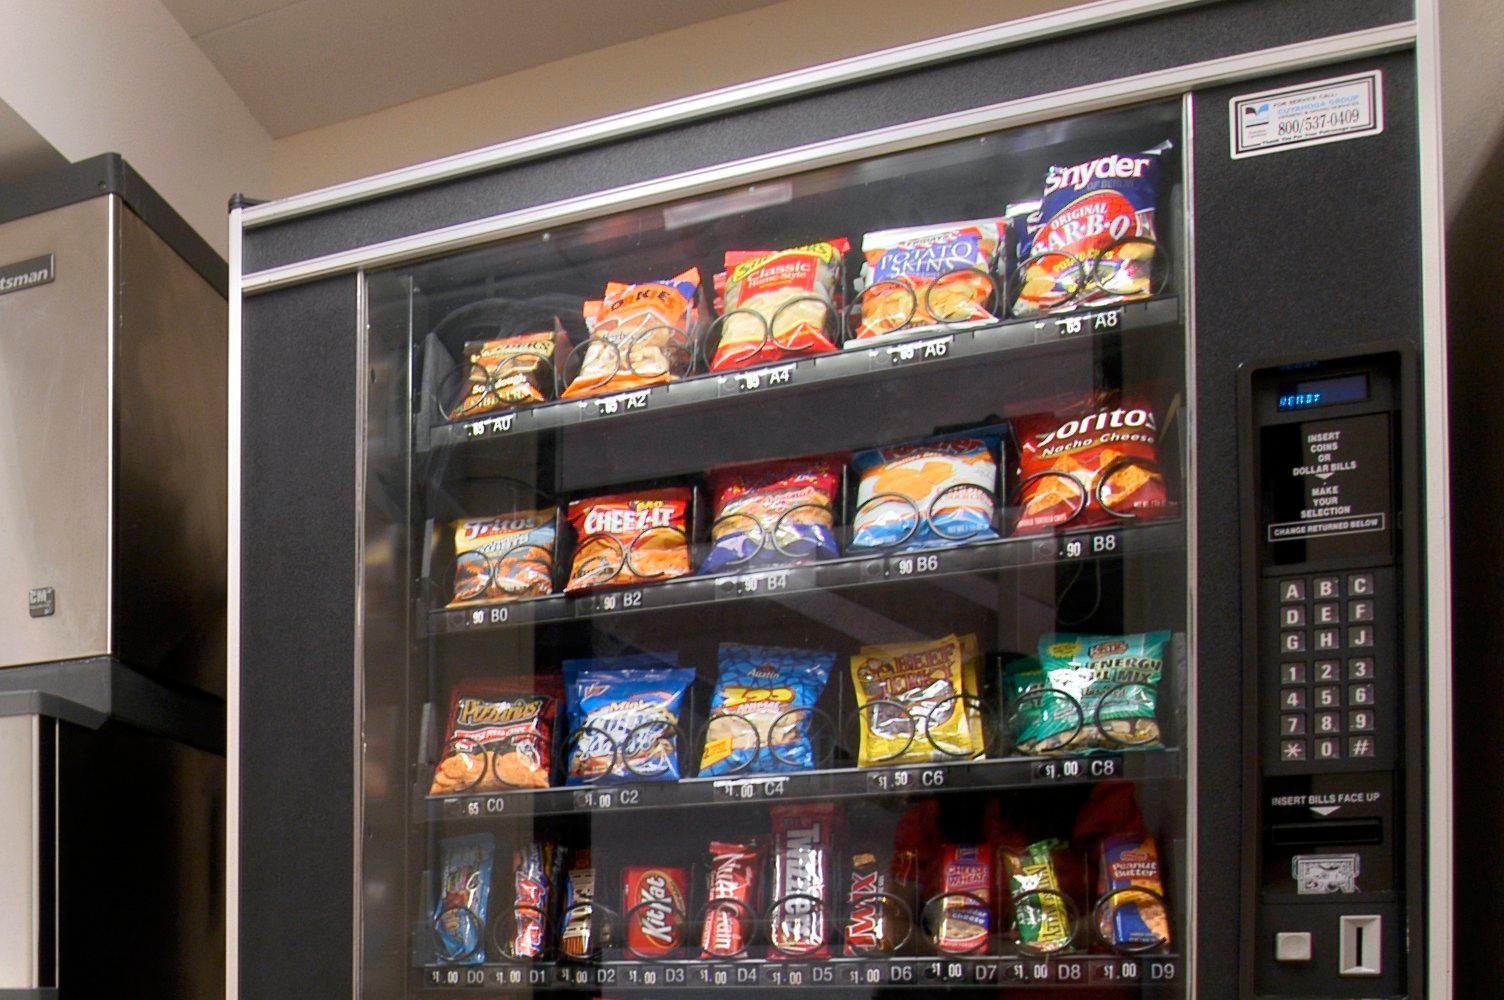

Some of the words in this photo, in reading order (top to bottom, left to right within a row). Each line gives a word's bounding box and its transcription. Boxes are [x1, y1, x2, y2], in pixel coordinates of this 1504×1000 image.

[1278, 109, 1359, 135] 800/537-0409
[1051, 202, 1108, 231] ORIGINAL
[881, 242, 973, 269] POTATO
[747, 262, 812, 283] Classic
[891, 257, 956, 275] SKINS
[1095, 311, 1117, 330] A8
[925, 342, 946, 358] A6
[769, 371, 789, 385] A4
[627, 394, 646, 408] A2
[493, 418, 510, 432] A0
[1042, 438, 1092, 457] Nacho
[1100, 431, 1154, 443] Cheese
[1307, 431, 1341, 443] INSERT
[1310, 442, 1338, 453] COINS
[1318, 453, 1331, 462] OR
[1293, 463, 1329, 476] DOLLAR
[1330, 460, 1357, 472] BILLS
[1312, 485, 1339, 496] MAKE
[1312, 496, 1338, 507] YOUR
[1300, 505, 1351, 519] SELECTION
[583, 506, 675, 535] CHEEZ-IT
[1273, 525, 1305, 537] CHANGE
[1307, 521, 1349, 534] RETURNED
[1350, 518, 1379, 529] BELOW
[1094, 535, 1115, 552] B8
[917, 556, 938, 573] B6
[768, 576, 787, 590] B4
[1286, 584, 1298, 598] A
[1320, 581, 1331, 596] B
[1355, 578, 1366, 593] C
[623, 592, 642, 607] B2
[491, 607, 508, 623] B0
[1287, 610, 1298, 624] D
[1322, 607, 1331, 621] E
[1356, 604, 1365, 618] F
[1287, 636, 1298, 649] G
[1321, 633, 1332, 647] H
[1355, 630, 1365, 645] J
[747, 667, 780, 680] Austin
[1117, 670, 1152, 683] MIX
[1289, 667, 1296, 680] 1
[1321, 665, 1331, 679] 2
[1355, 662, 1365, 676] 3
[1287, 693, 1297, 706] 4
[1322, 691, 1331, 704] 5
[1356, 688, 1365, 702] 6
[1288, 718, 1297, 732] 7
[1322, 716, 1331, 730] 8
[1356, 714, 1366, 728] 9
[1322, 743, 1331, 756] 0
[1353, 740, 1368, 754] #
[1091, 760, 1114, 776] C8
[922, 770, 944, 786] C6
[765, 782, 784, 795] C4
[620, 790, 639, 804] C2
[1271, 796, 1306, 806] INSERT
[1308, 795, 1336, 804] BILLS
[1338, 793, 1364, 802] FACE
[1366, 792, 1381, 801] UP
[487, 798, 504, 812] C0
[1112, 861, 1157, 872] Peanut
[1113, 869, 1157, 878] Butter
[784, 823, 821, 937] Twizzler
[467, 970, 484, 983] D0
[529, 969, 545, 983] D1
[597, 969, 615, 983] D2
[666, 969, 684, 982] D3
[737, 968, 757, 982] D4
[812, 967, 833, 982] D5
[891, 966, 912, 981] D6
[975, 964, 996, 979] D7
[1058, 964, 1081, 979] D8
[1151, 963, 1175, 979] D9
